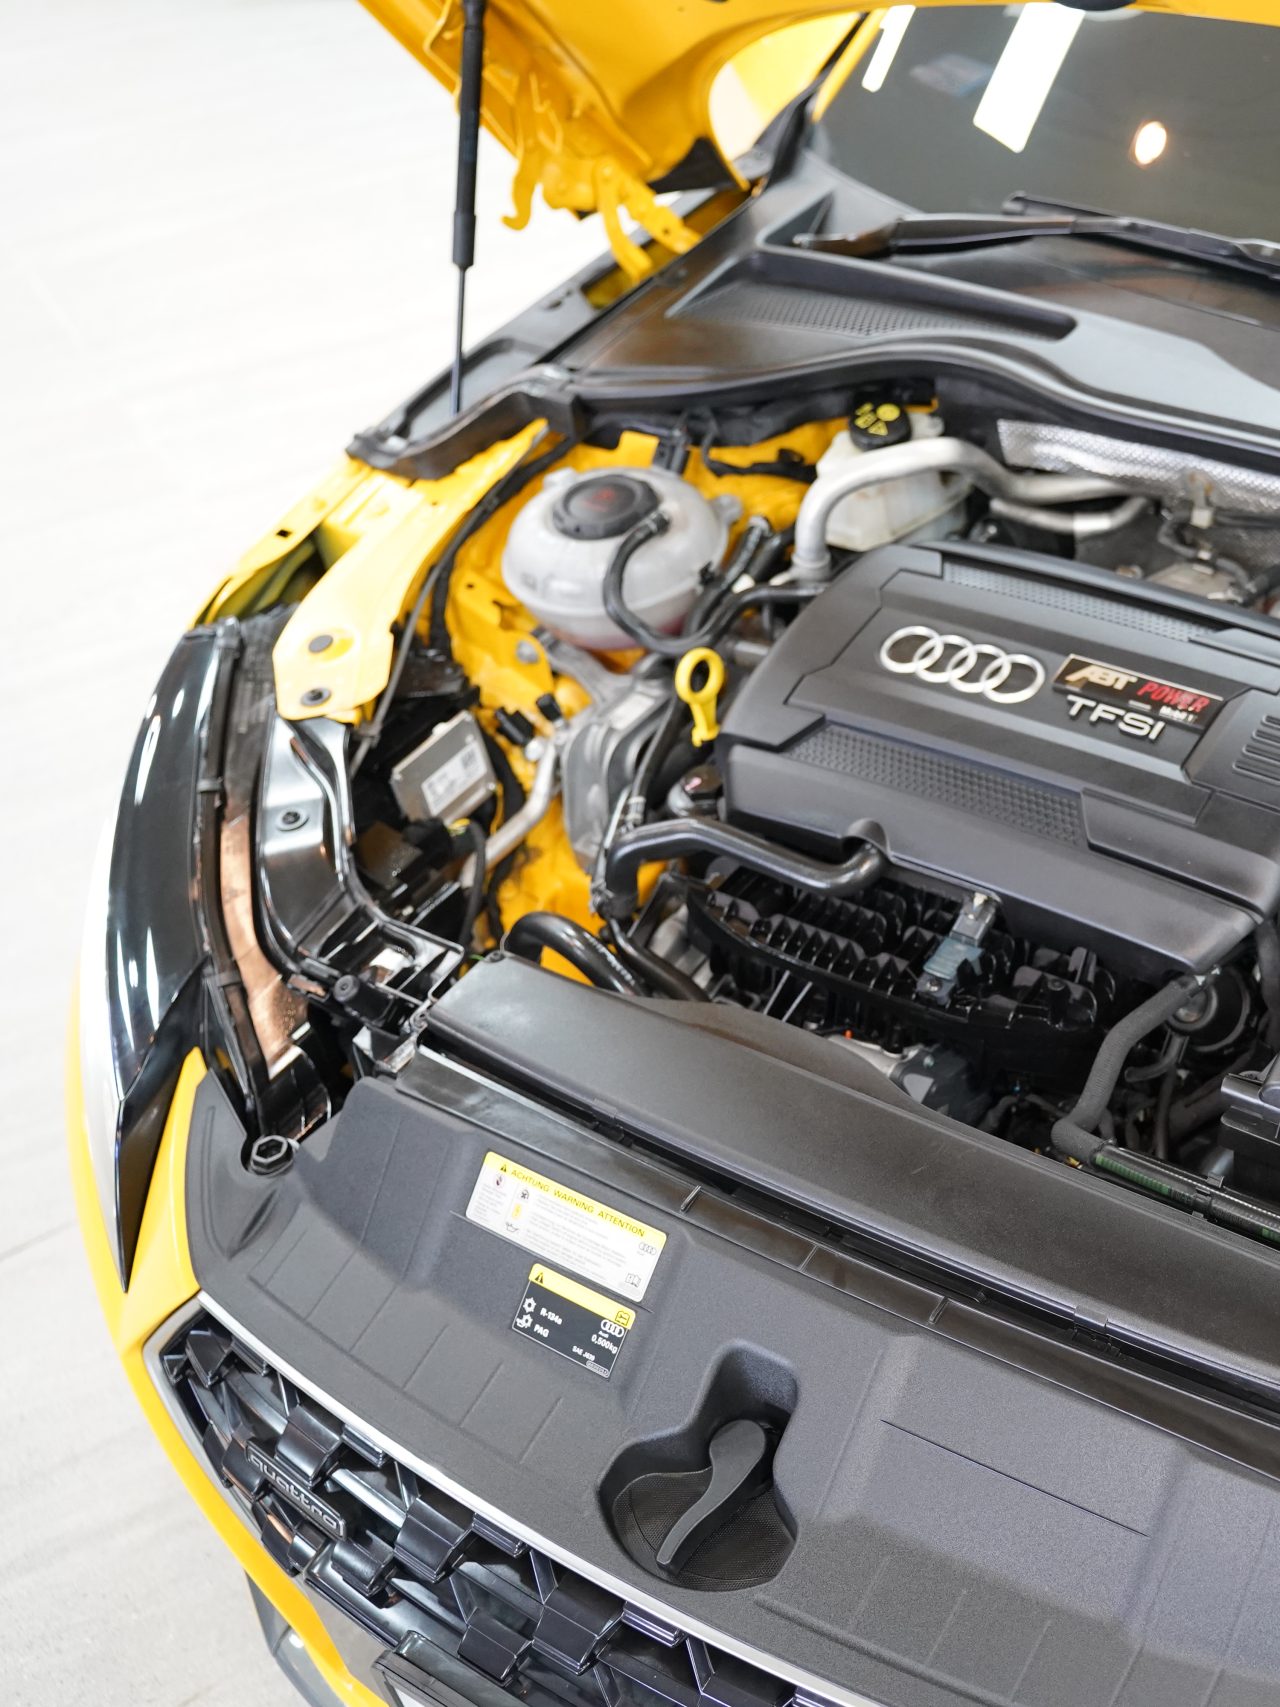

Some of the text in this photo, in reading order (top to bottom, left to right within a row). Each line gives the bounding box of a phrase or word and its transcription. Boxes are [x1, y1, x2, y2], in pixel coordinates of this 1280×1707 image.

[1065, 663, 1211, 713] ABT POWER
[1067, 694, 1166, 740] TFSI
[511, 1169, 551, 1193] ACHTUNG
[554, 1189, 594, 1214] WARNING
[598, 1210, 646, 1238] ATTENTION
[533, 1323, 549, 1338] PAG
[540, 1307, 563, 1325] R-134a
[572, 1345, 584, 1356] SAE
[248, 1453, 337, 1529] quattro
